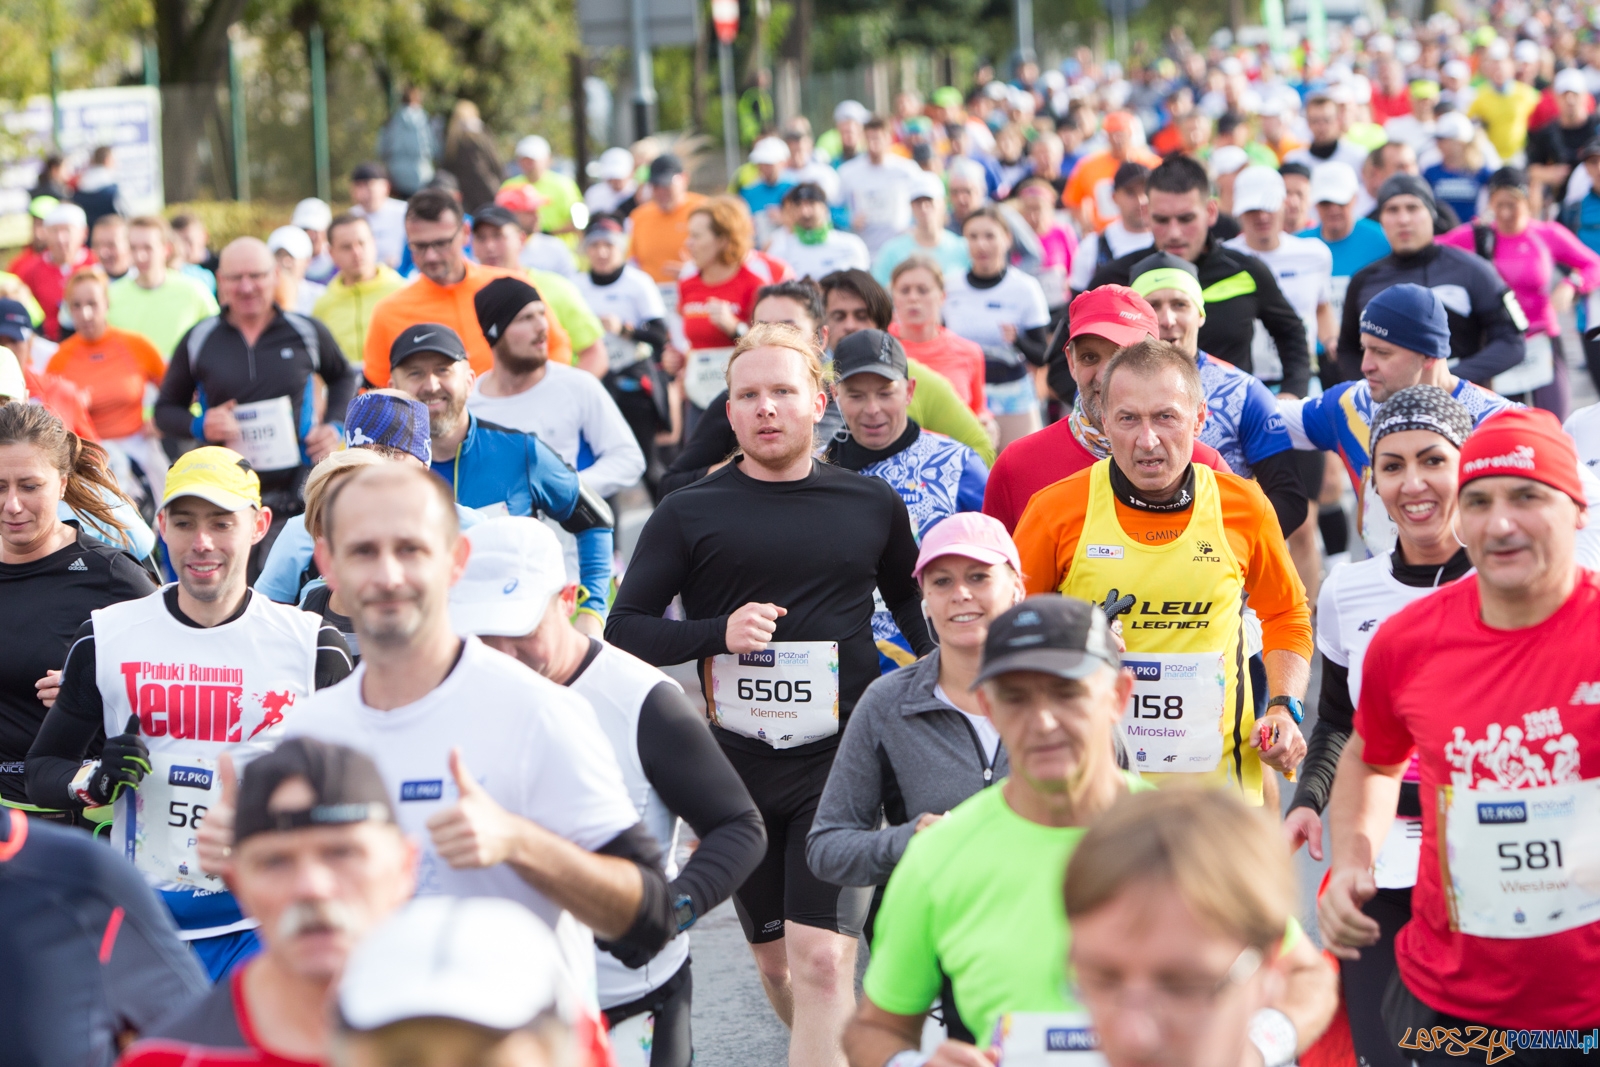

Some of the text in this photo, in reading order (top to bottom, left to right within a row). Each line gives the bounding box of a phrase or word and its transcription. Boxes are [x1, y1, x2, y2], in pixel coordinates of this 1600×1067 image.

[1146, 529, 1185, 541] GMIN
[1140, 601, 1213, 615] LEW
[1131, 620, 1210, 630] LEGNICA
[189, 664, 243, 686] Running
[737, 678, 812, 703] 6505
[120, 661, 243, 743] Team
[1131, 694, 1183, 719] 158
[750, 707, 798, 719] Klemens
[1127, 725, 1187, 737] Mirosław
[1498, 839, 1563, 872] 581
